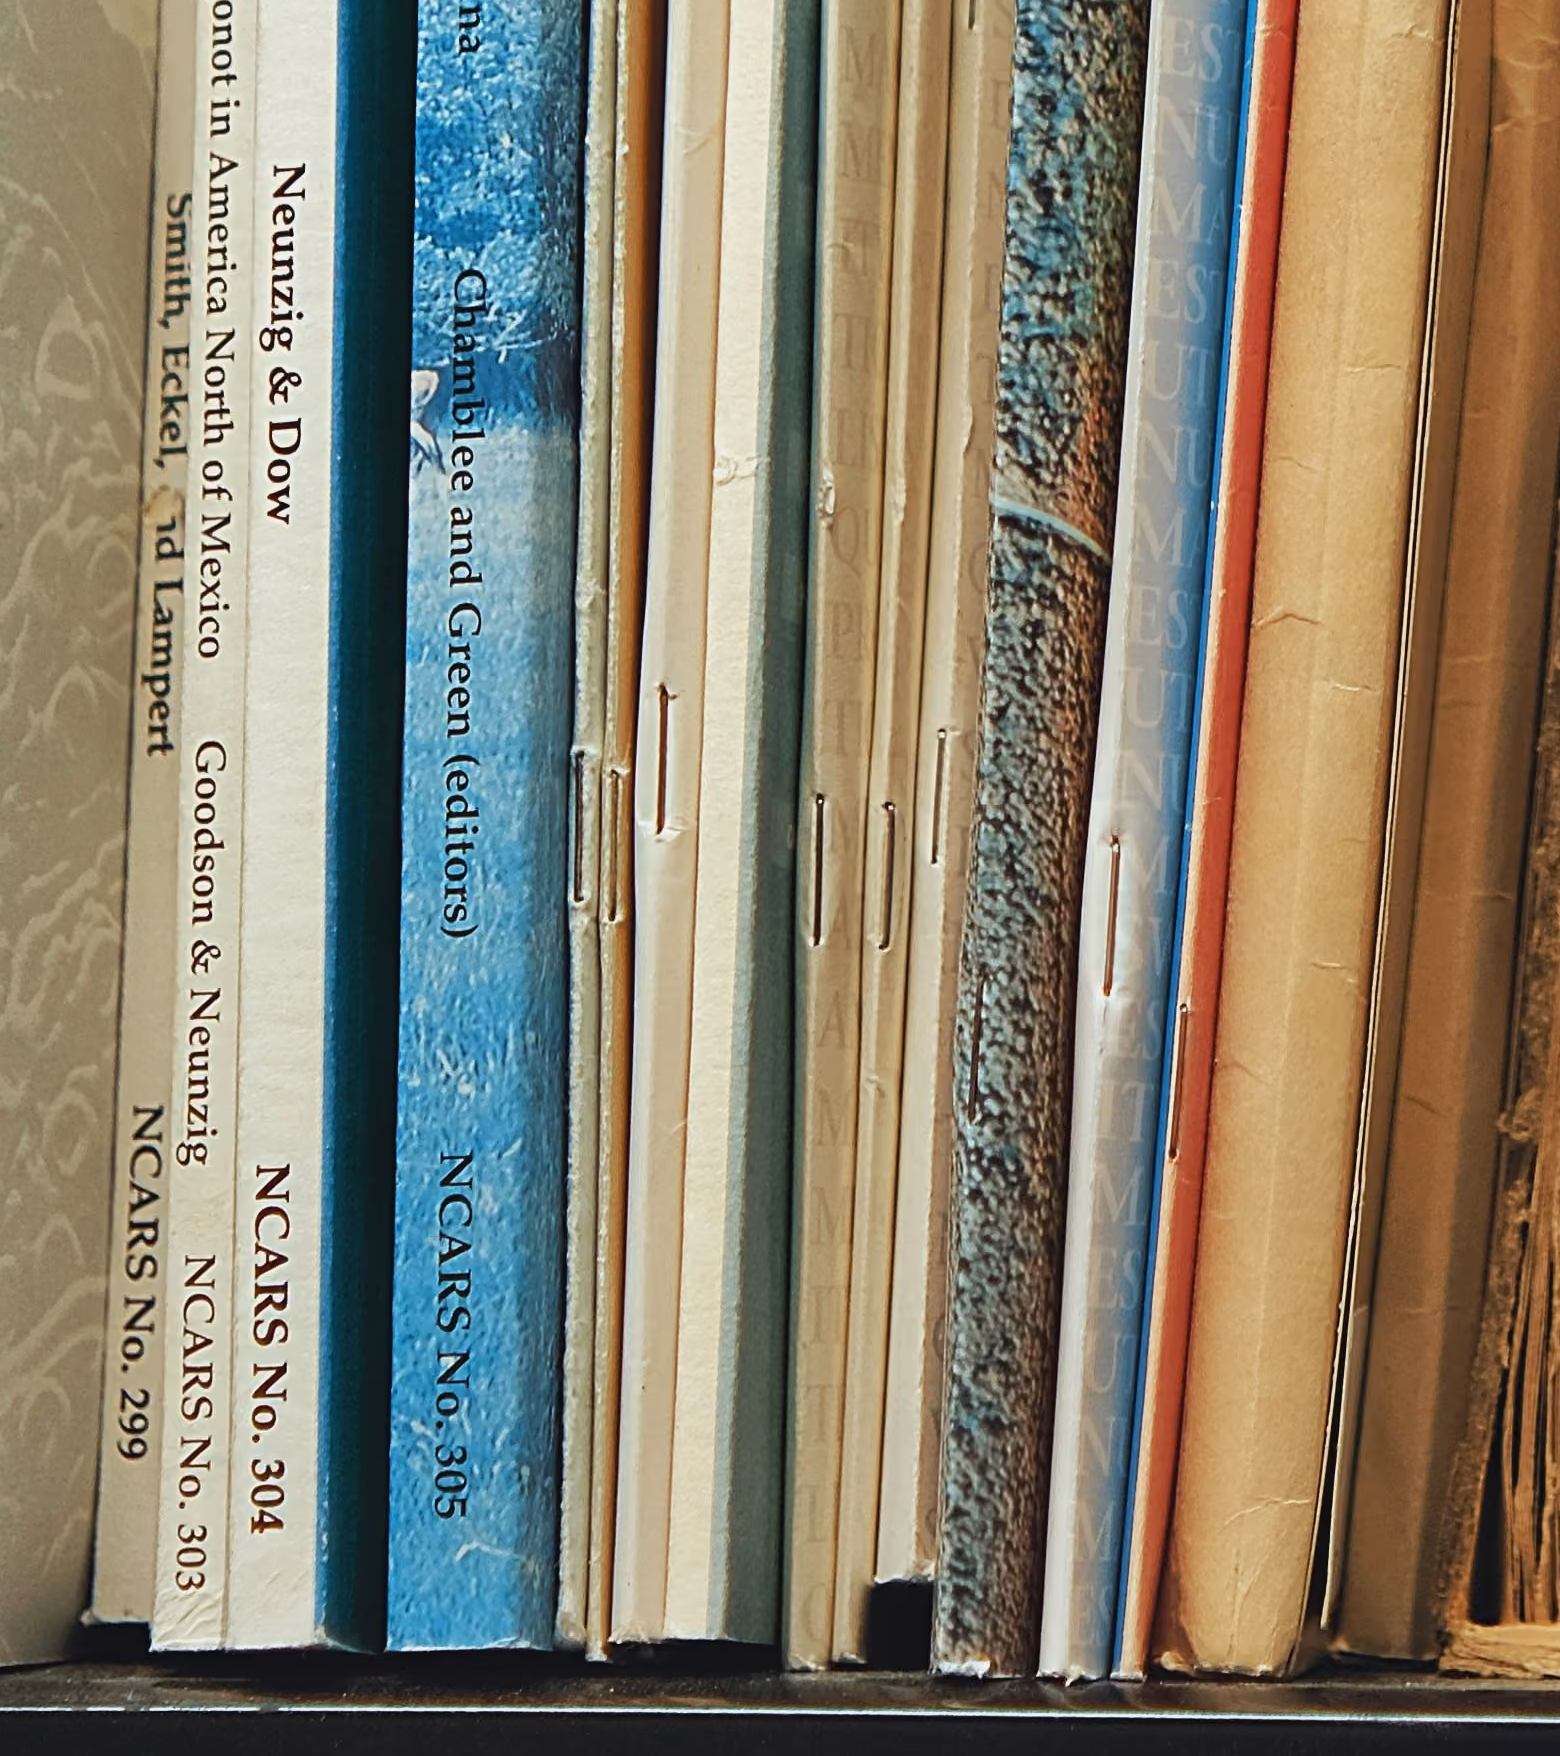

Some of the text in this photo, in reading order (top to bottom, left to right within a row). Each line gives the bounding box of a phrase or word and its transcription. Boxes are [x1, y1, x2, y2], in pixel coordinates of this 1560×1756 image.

[201, 151, 239, 316] America
[206, 99, 242, 138] in
[139, 192, 194, 756] Smith, Eckel, Lampert
[197, 459, 234, 502] of
[199, 327, 237, 447] North
[257, 163, 309, 525] Neunzig & Dow
[193, 513, 231, 660] Mexico
[436, 268, 488, 939] Chamblee and Green (editors)
[175, 738, 227, 1167] Goodson & Neunzig
[115, 1104, 166, 1460] NCARS No. 299
[172, 1253, 216, 1592] NCARS No. 303
[247, 1163, 291, 1535] NCARS No. 304
[431, 1150, 472, 1520] NCARS No. 305
